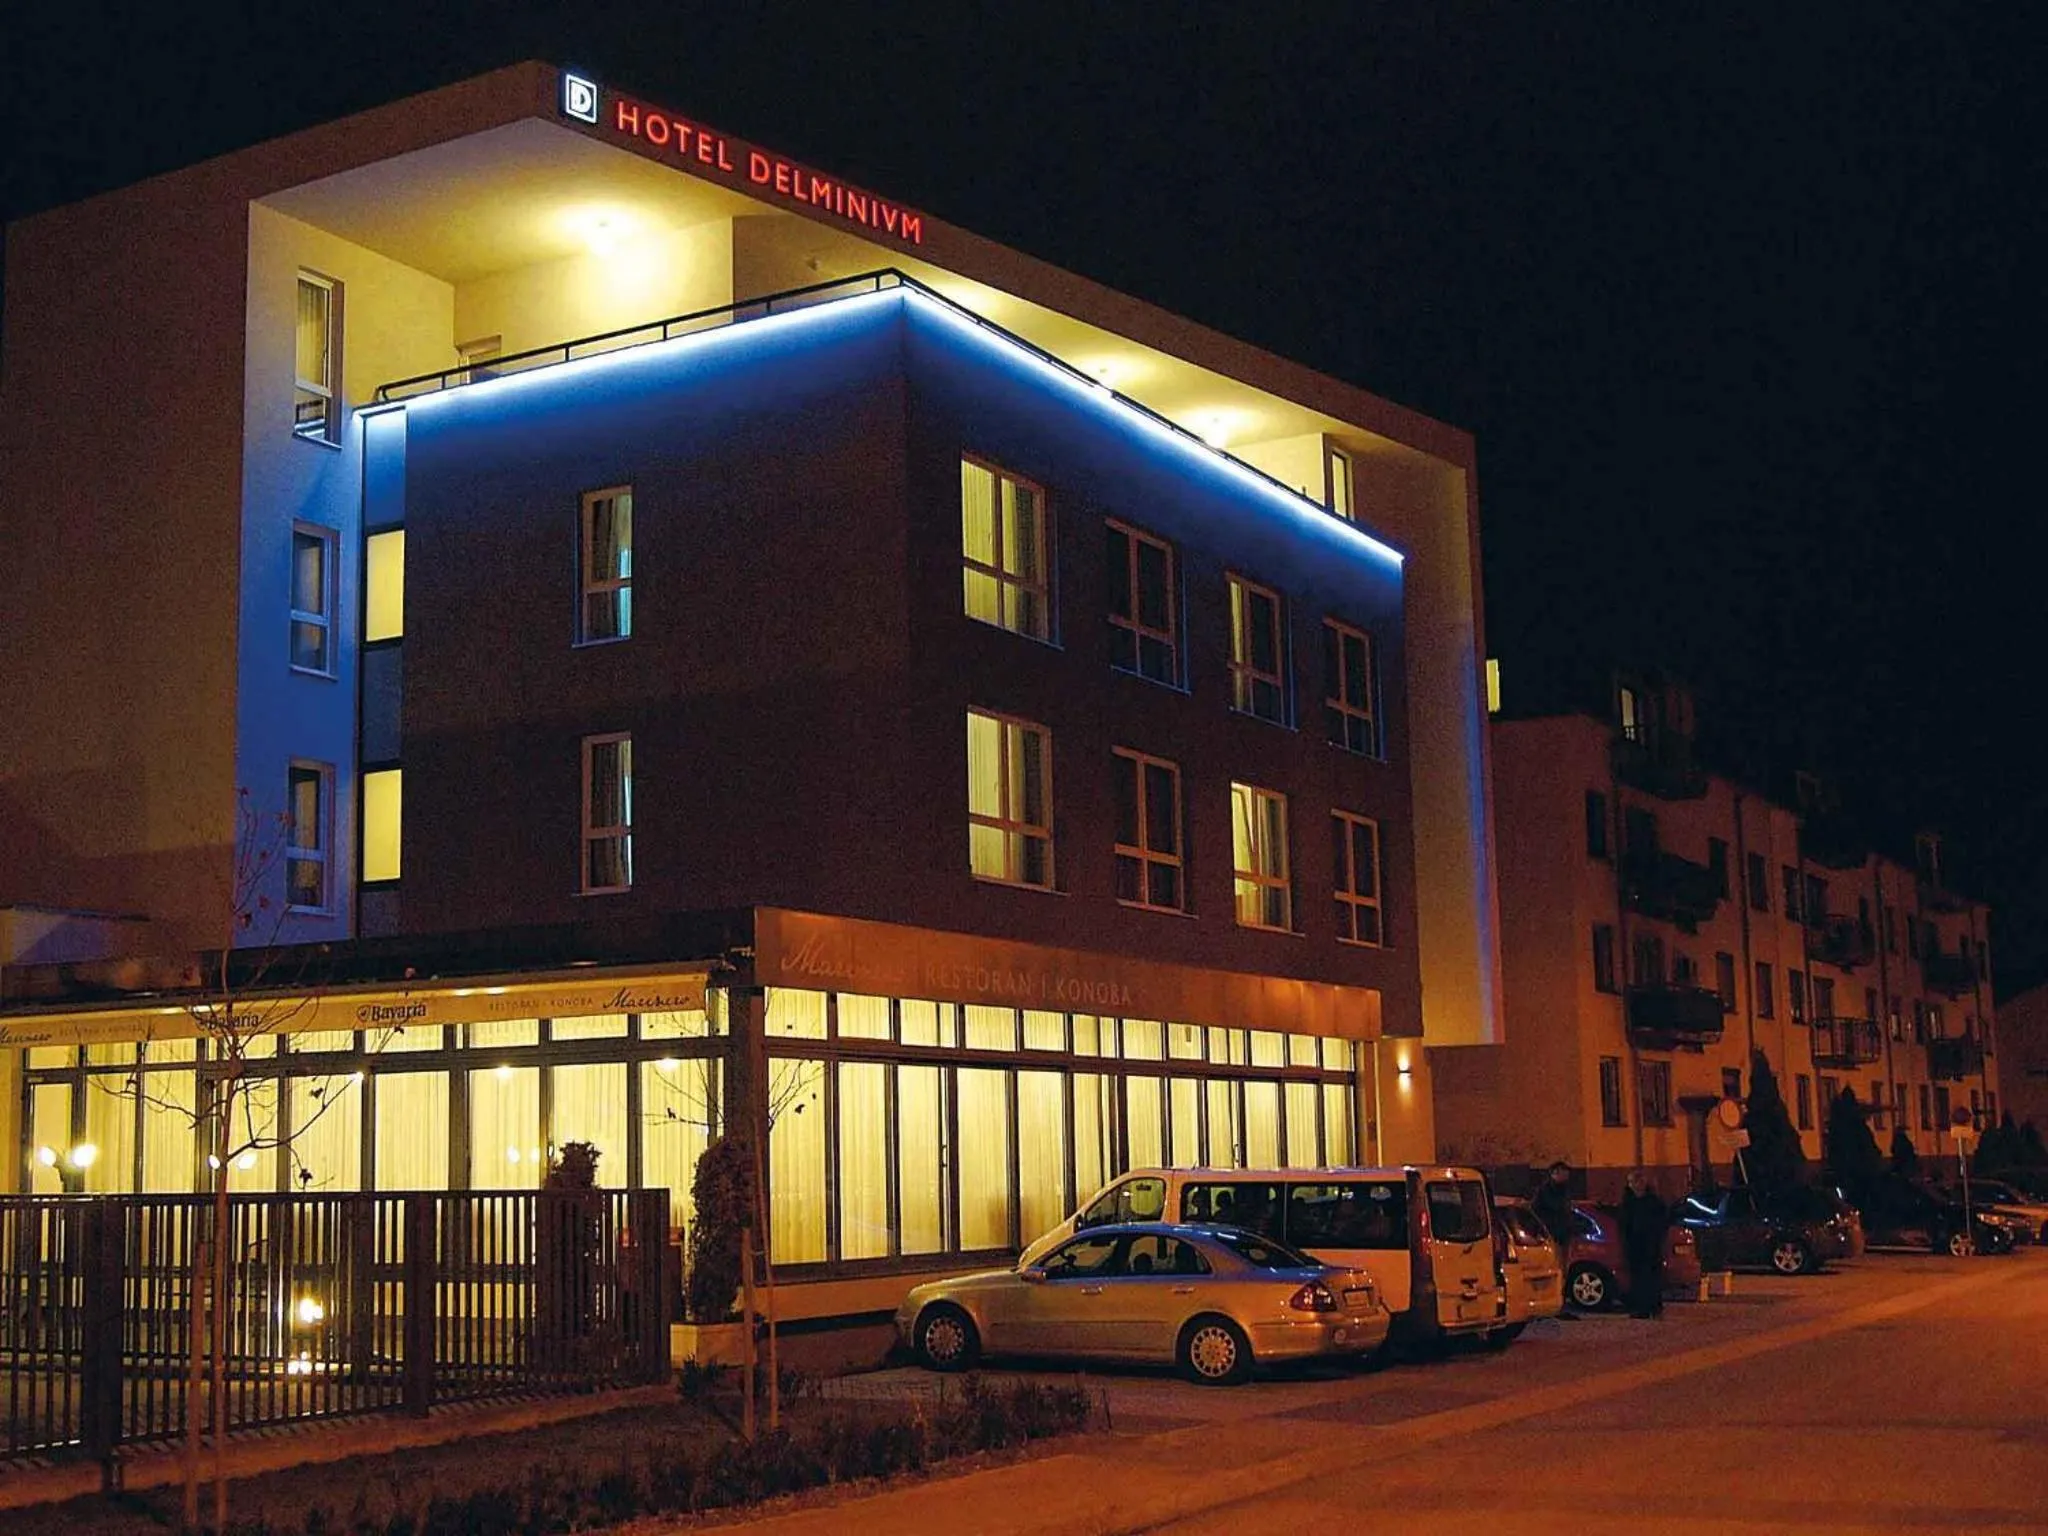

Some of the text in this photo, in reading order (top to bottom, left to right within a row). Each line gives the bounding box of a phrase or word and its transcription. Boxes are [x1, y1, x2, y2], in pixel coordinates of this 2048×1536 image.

[618, 101, 921, 244] HOTEL DELMINIVM
[925, 961, 1032, 996] RESTORAN
[1056, 976, 1132, 1006] KONOBA
[207, 1011, 259, 1029] Baaria
[371, 1002, 427, 1021] Bavaria
